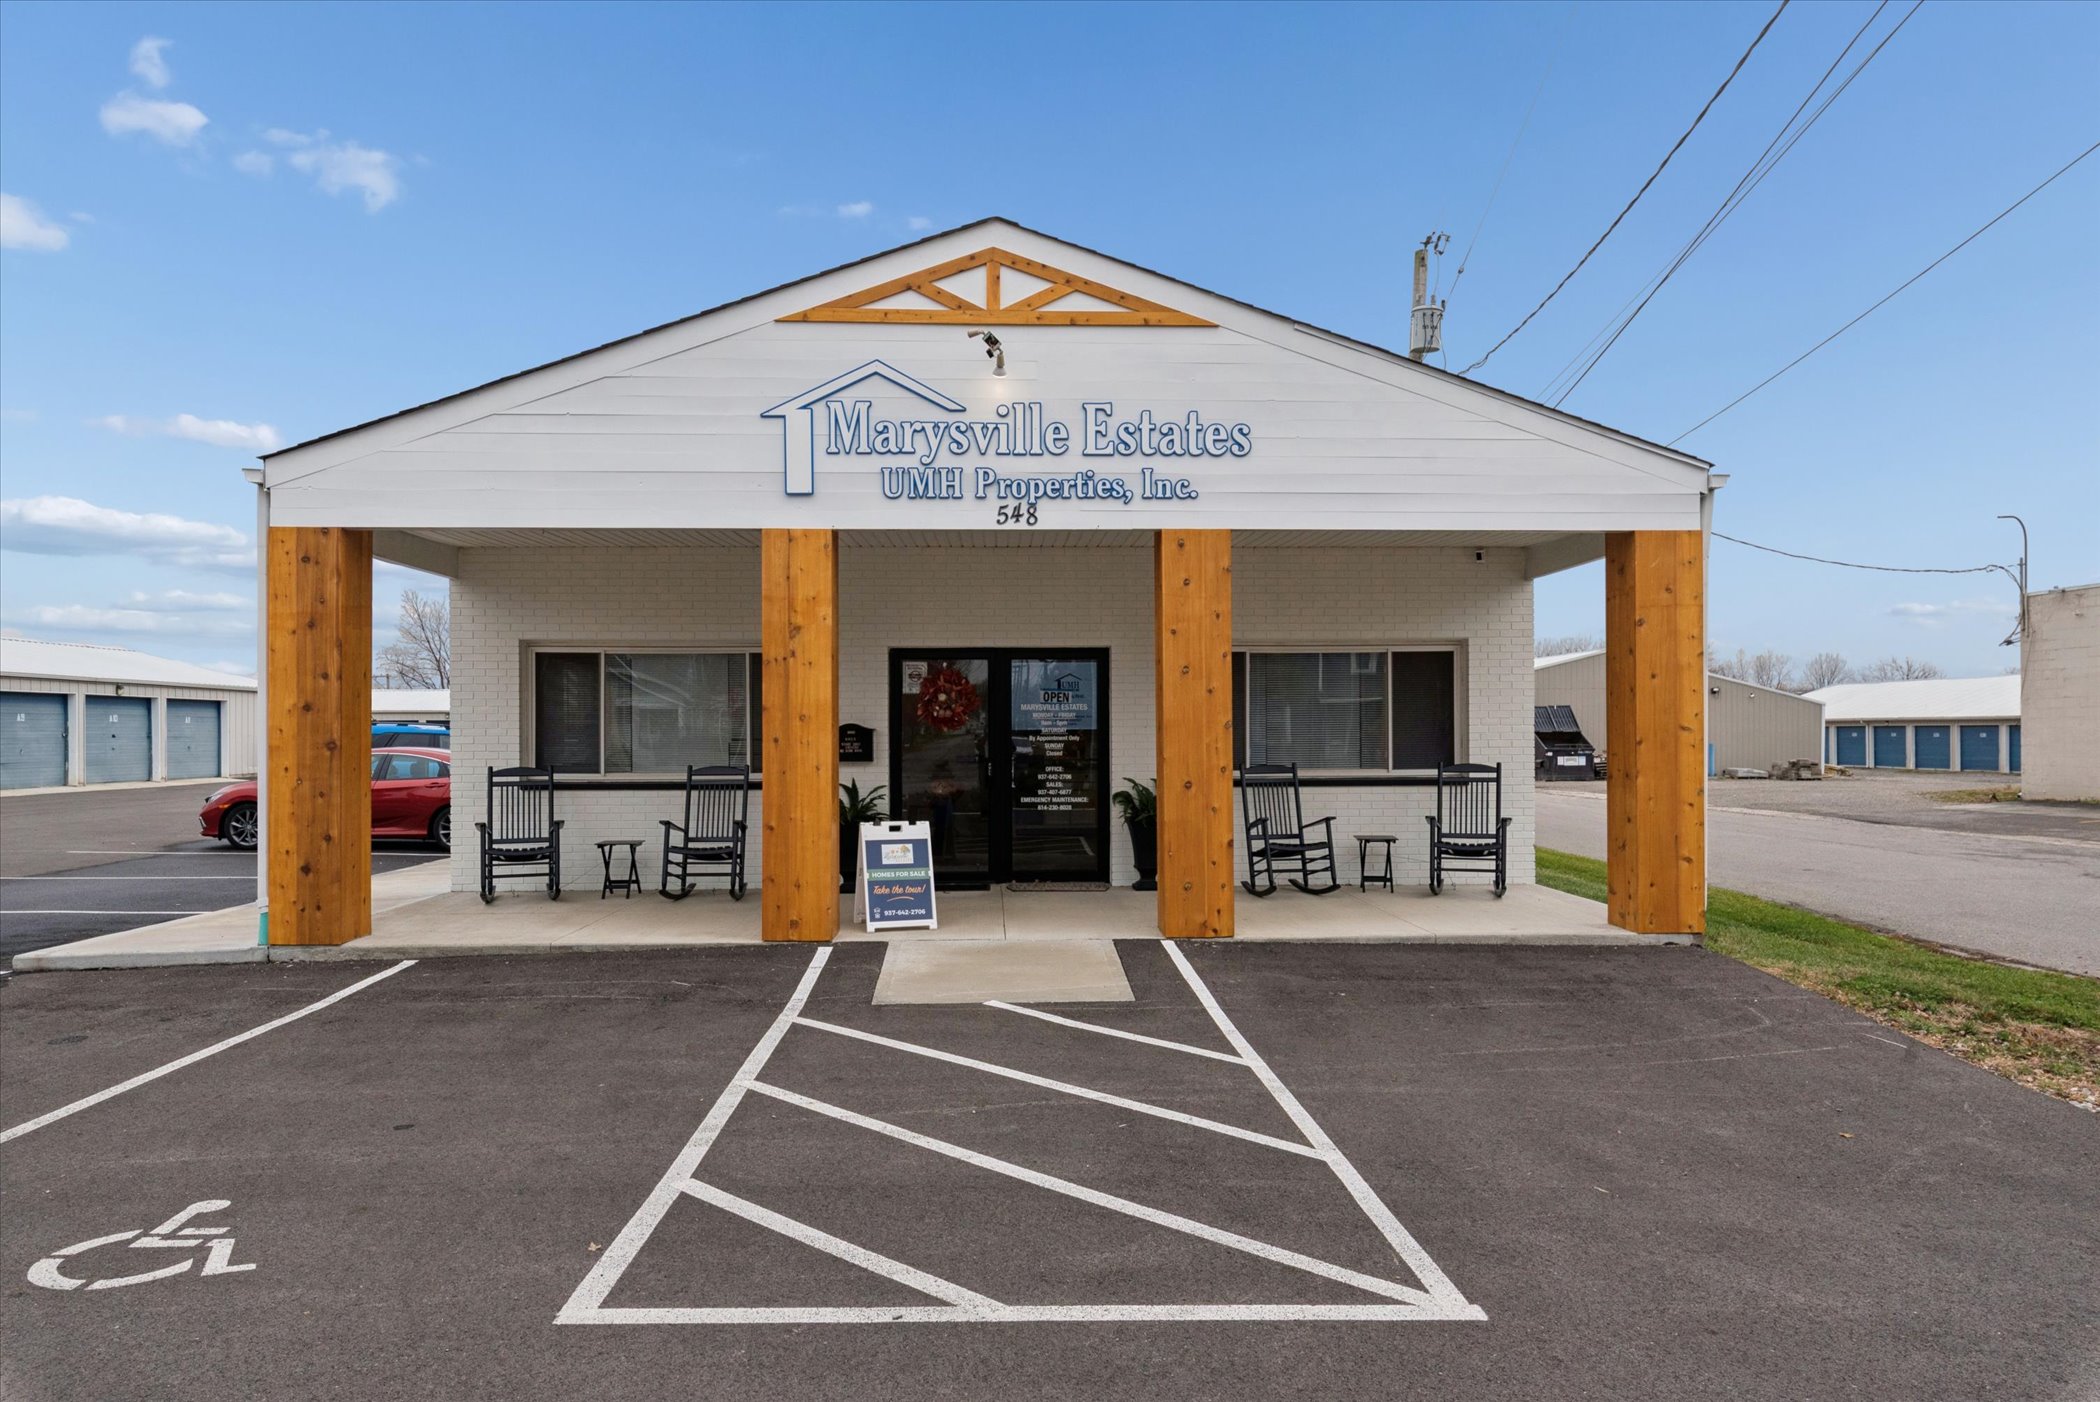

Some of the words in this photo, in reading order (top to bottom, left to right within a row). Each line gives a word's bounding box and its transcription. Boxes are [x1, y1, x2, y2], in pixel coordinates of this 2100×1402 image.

[825, 400, 1069, 466] Marysville
[1081, 401, 1252, 457] Estates
[880, 466, 964, 500] UMH
[974, 468, 1133, 504] Properties,
[1141, 468, 1199, 500] Inc.
[996, 503, 1039, 526] 548
[1062, 681, 1080, 689] UMH
[1043, 692, 1070, 702] OPEN
[873, 885, 890, 895] Take
[891, 885, 904, 894] the
[905, 884, 926, 894] tour!
